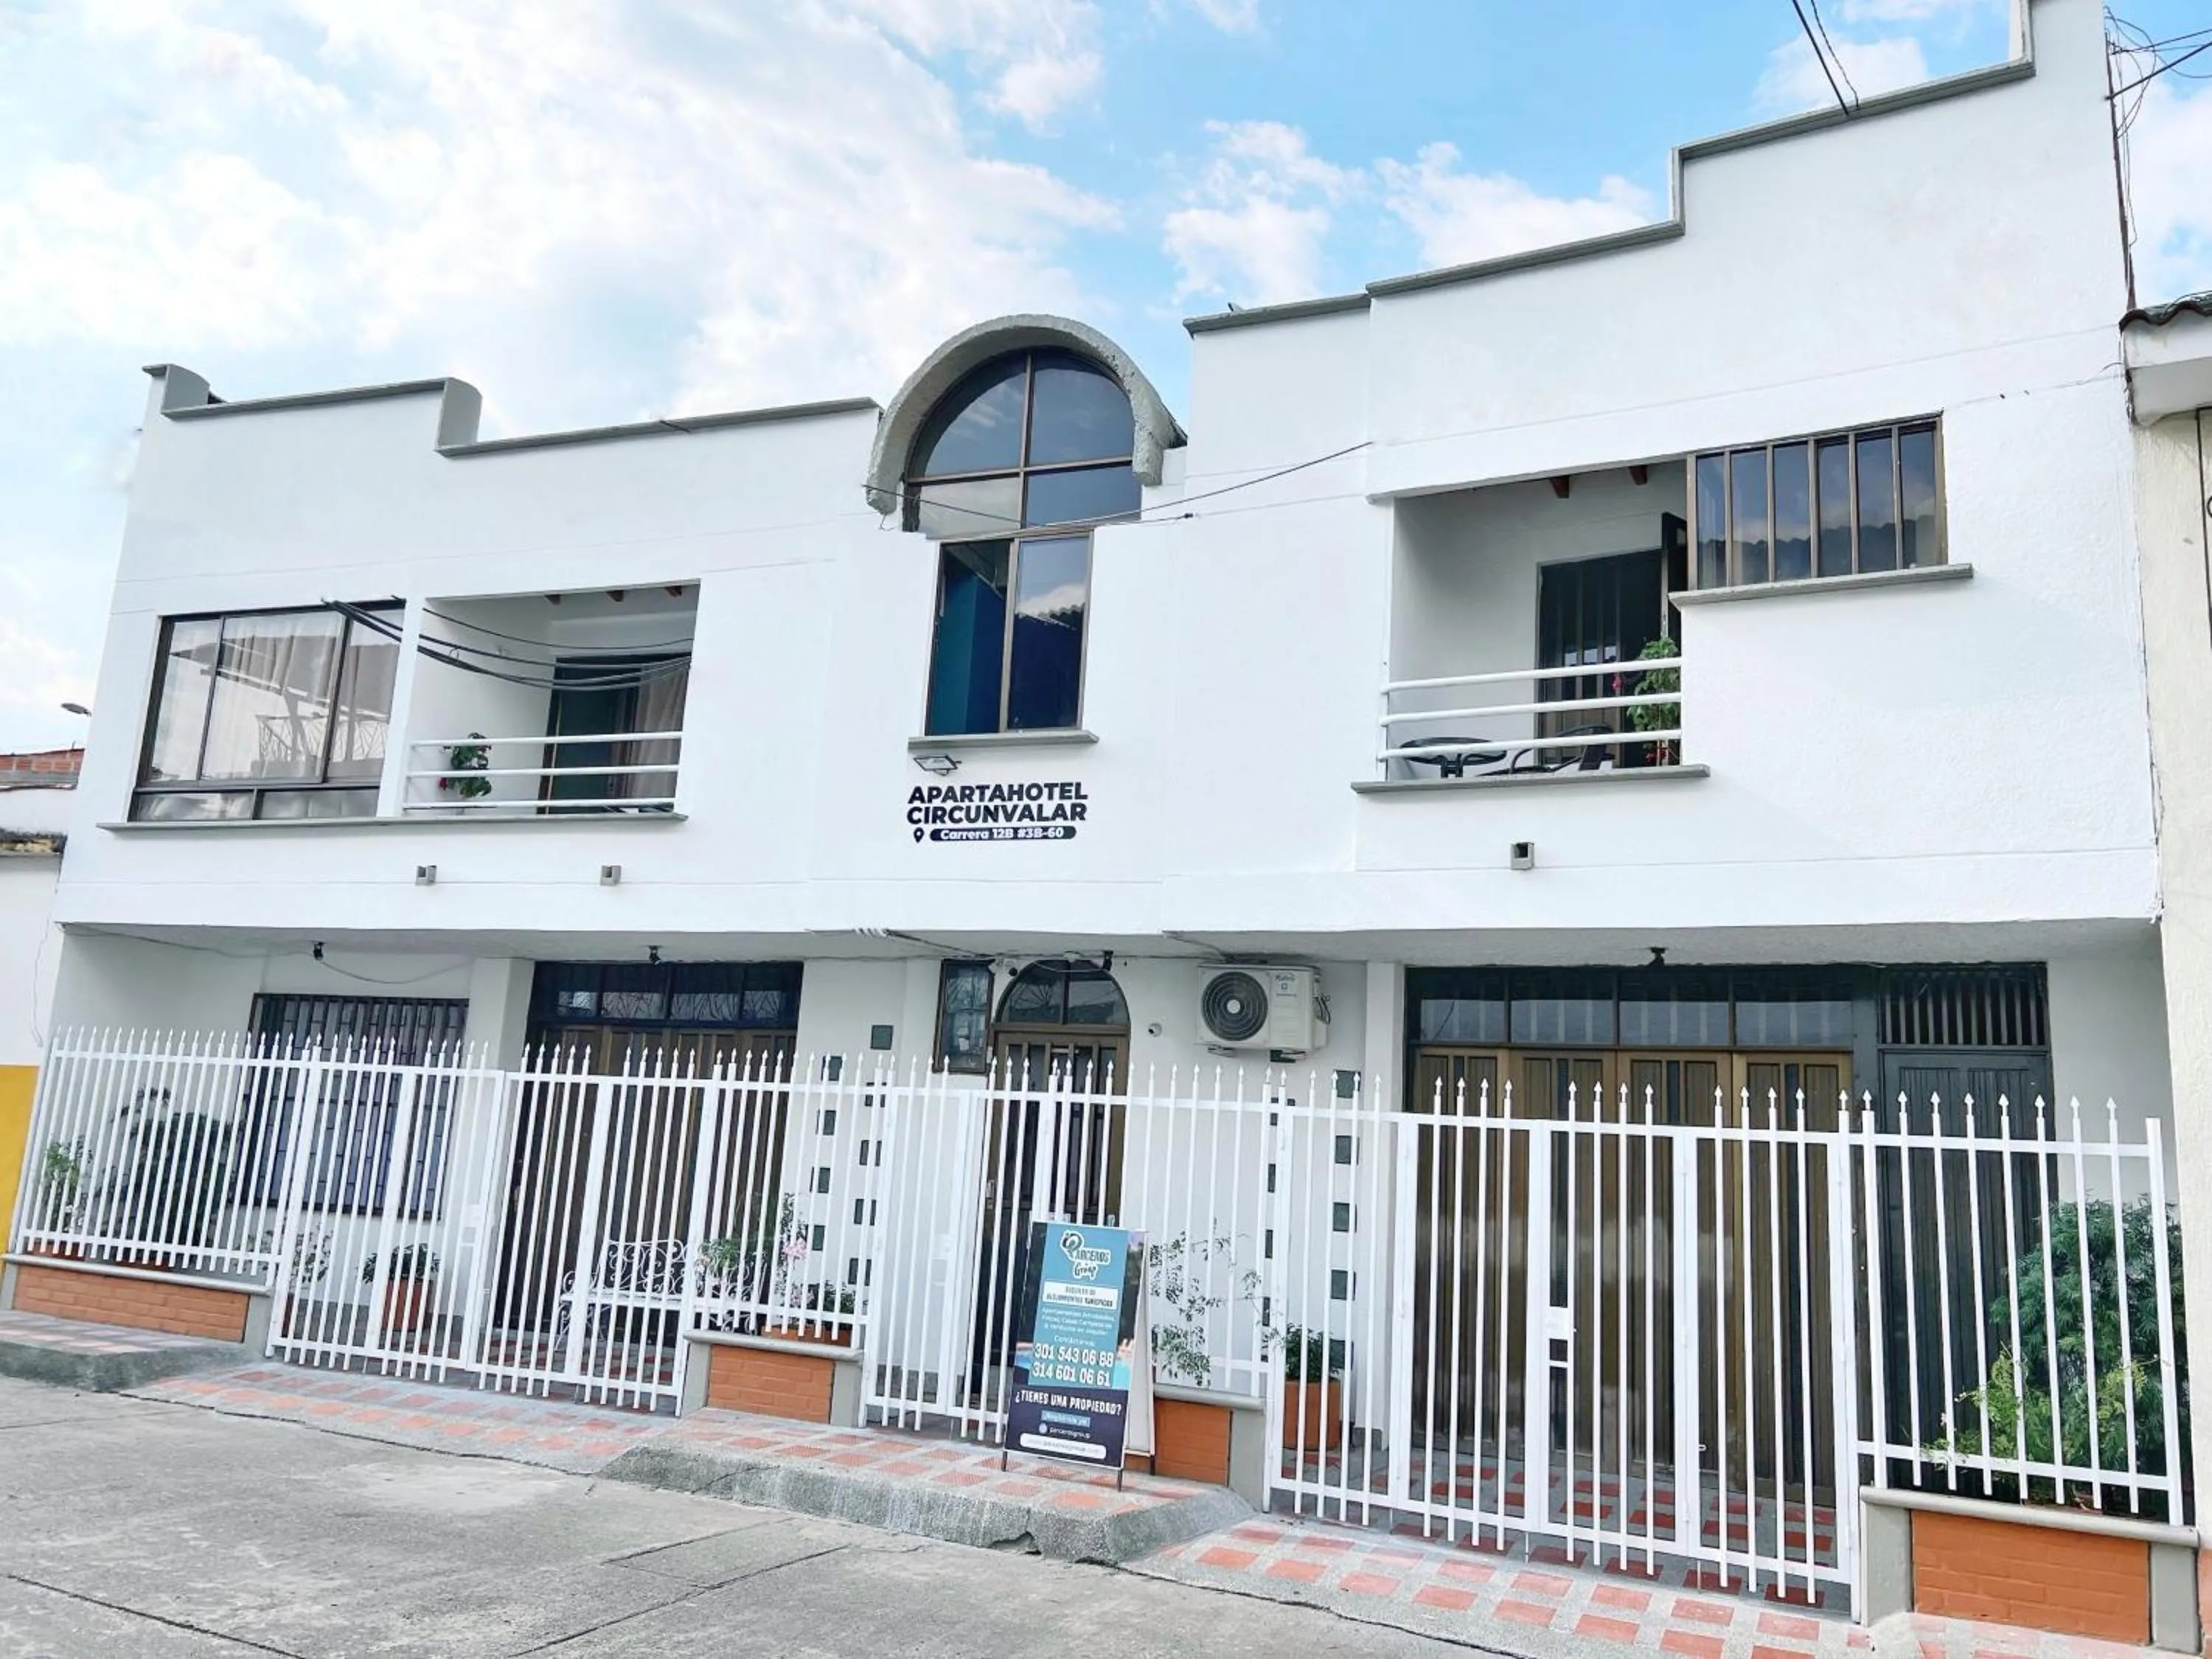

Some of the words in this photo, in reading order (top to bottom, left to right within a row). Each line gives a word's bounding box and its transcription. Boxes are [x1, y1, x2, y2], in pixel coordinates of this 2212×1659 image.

[908, 782, 1088, 804] APARTAHOTEL
[906, 803, 1087, 824] CIRCUNVALAR
[940, 830, 989, 840] Carrera
[992, 827, 1014, 838] 12B
[1034, 1343, 1055, 1360] 301
[1057, 1346, 1080, 1363] 543
[1081, 1349, 1096, 1366] 06
[1032, 1361, 1054, 1379] 314
[1055, 1365, 1076, 1382] 601
[1015, 1390, 1049, 1405] ¿TIENES
[1051, 1394, 1067, 1408] UNA
[1069, 1397, 1122, 1416] PROPIEDAD?
